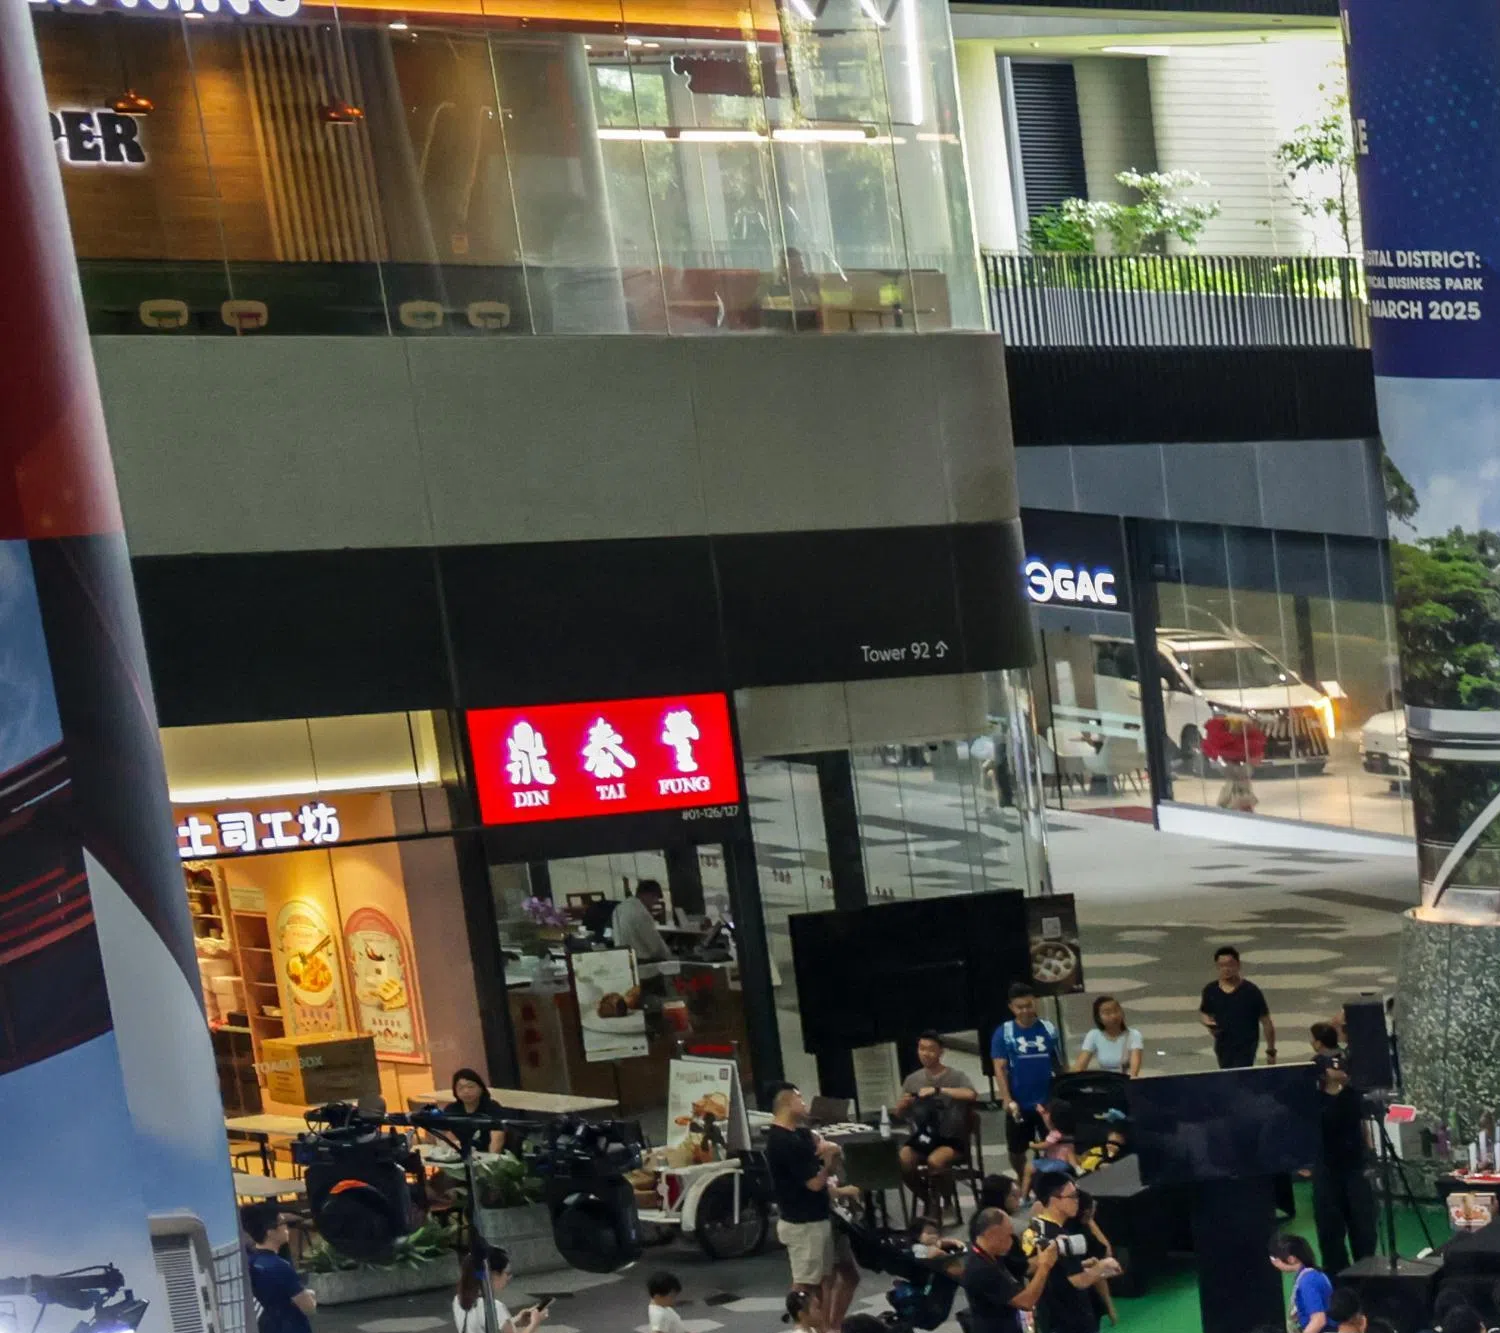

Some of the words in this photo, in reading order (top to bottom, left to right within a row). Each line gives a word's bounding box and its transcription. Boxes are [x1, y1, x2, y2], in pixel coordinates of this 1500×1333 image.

[1396, 249, 1482, 270] DISTRICT:
[1428, 300, 1481, 322] 2025
[1054, 568, 1117, 605] GAC
[861, 643, 908, 663] Tower
[910, 642, 932, 660] 92
[513, 788, 550, 809] DIN
[595, 782, 628, 801] TAI
[657, 774, 710, 795] FUNG
